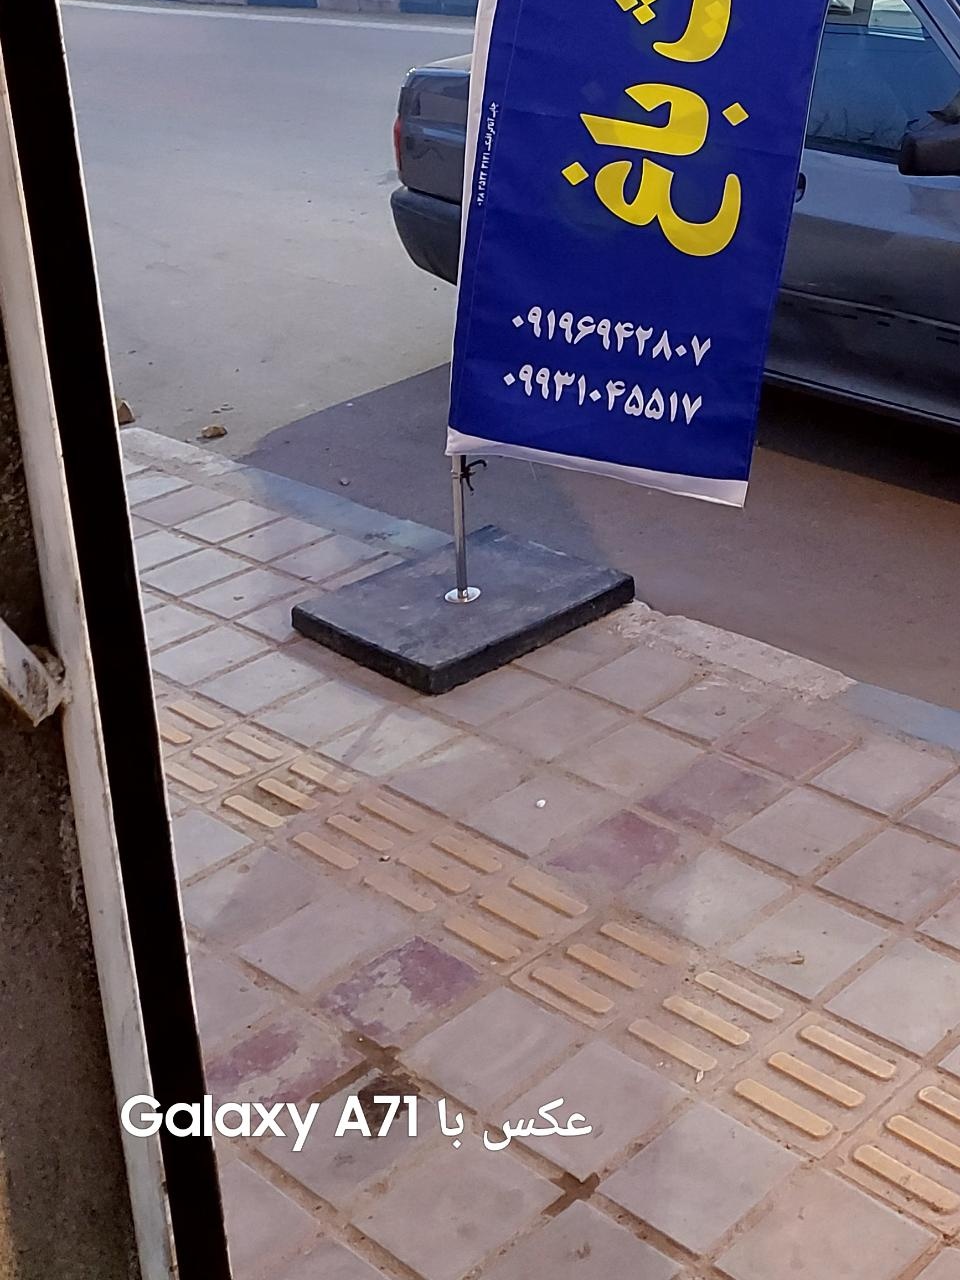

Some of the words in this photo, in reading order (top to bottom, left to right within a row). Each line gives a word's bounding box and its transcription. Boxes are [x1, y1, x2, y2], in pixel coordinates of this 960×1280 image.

[561, 82, 750, 257] باغ
[511, 305, 711, 367] ۰۹۱۹۶۹۴۲۸۰۷
[503, 364, 703, 425] ۰۹۹۳۱۰۴۵۵۱۷
